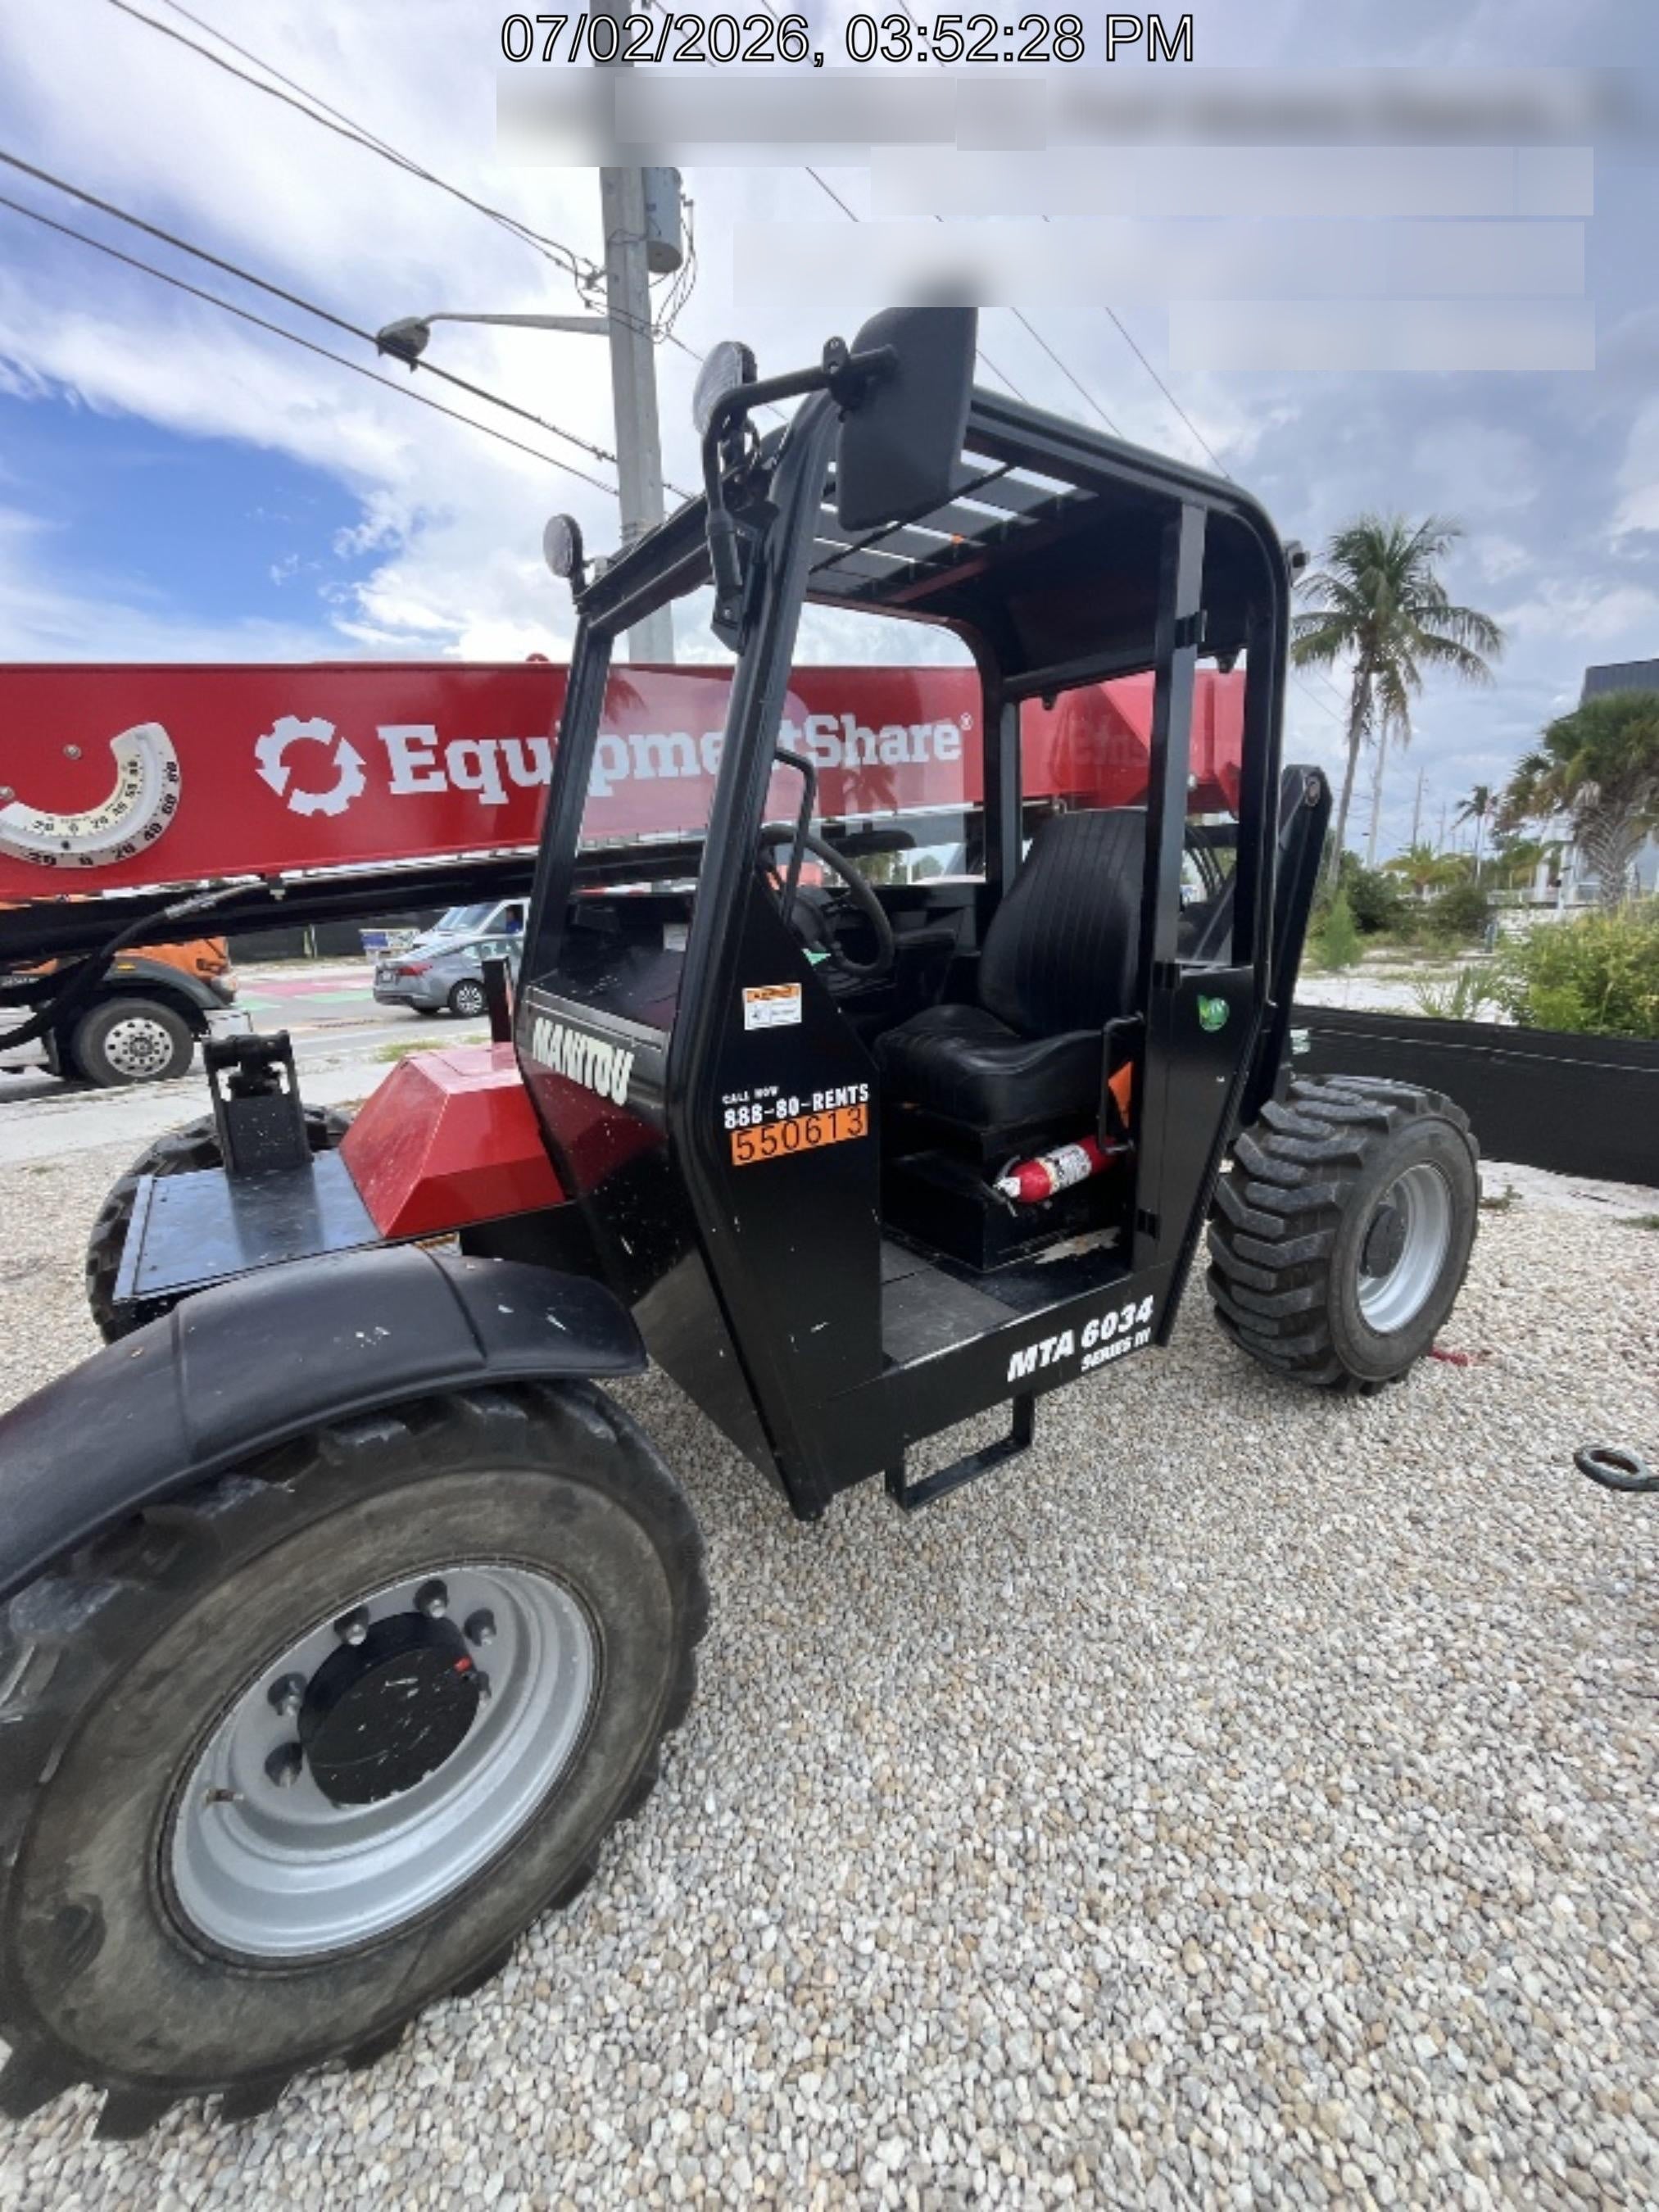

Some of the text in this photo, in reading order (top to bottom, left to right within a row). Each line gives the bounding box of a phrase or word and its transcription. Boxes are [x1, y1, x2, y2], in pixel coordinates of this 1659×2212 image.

[533, 1017, 635, 1106] MANITOU
[722, 1086, 779, 1105] CALL NOW
[723, 1083, 869, 1130] 888-80-RENTS
[736, 1106, 863, 1162] 550613
[1007, 1294, 1154, 1383] MTA 6034
[1081, 1336, 1132, 1372] SERIES
